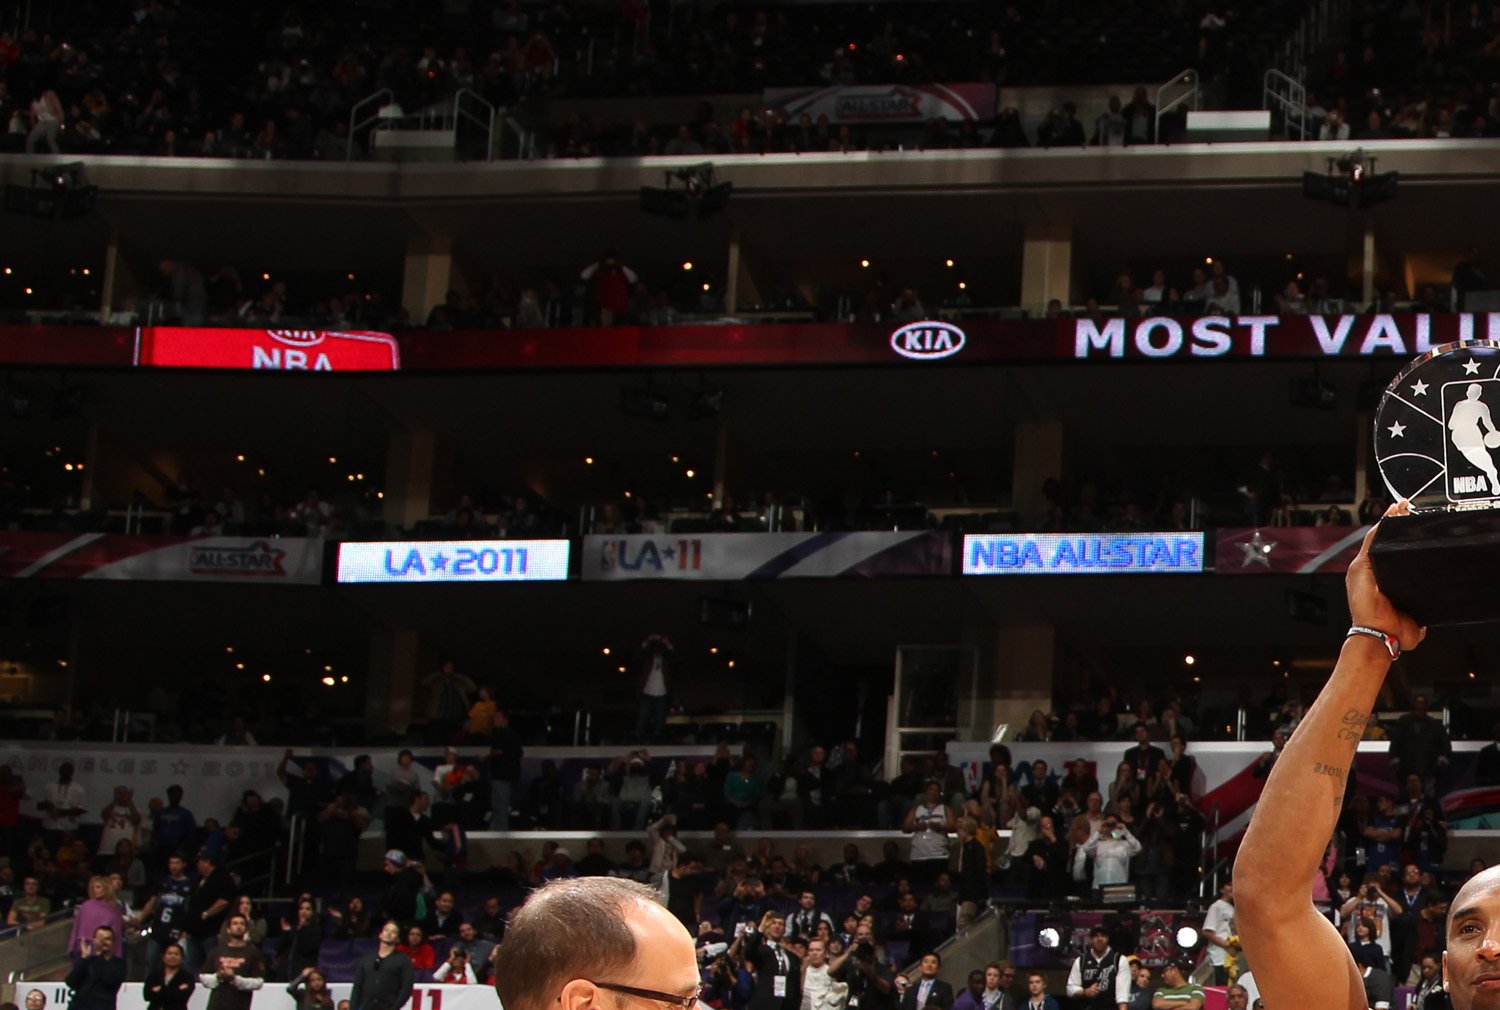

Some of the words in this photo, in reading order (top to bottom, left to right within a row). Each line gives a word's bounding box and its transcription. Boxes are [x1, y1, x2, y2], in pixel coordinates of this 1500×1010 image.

[904, 330, 952, 350] KIA
[1075, 316, 1279, 358] MOST
[252, 345, 332, 371] NBA
[1453, 475, 1488, 493] NBA
[384, 548, 426, 575] LA
[451, 547, 529, 575] 2011
[618, 539, 664, 571] LA
[677, 539, 701, 570] 11
[971, 540, 1043, 568] NBA
